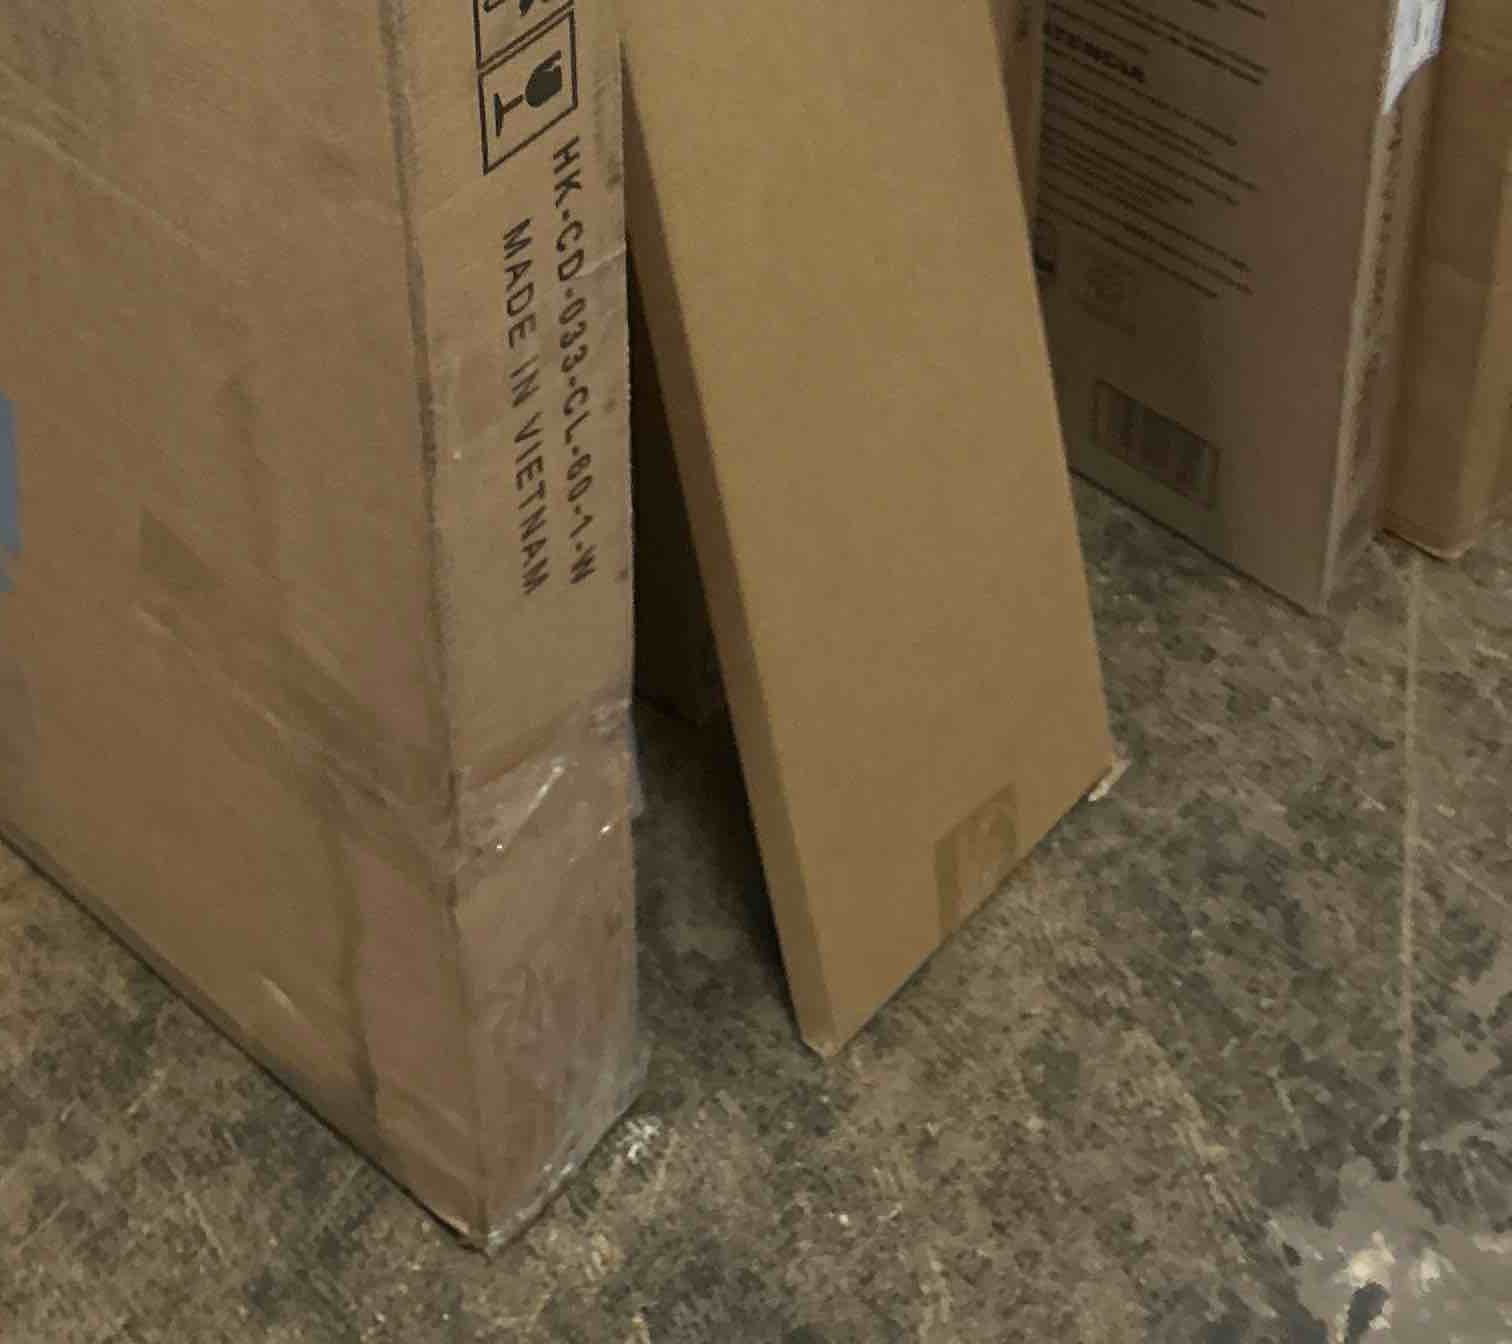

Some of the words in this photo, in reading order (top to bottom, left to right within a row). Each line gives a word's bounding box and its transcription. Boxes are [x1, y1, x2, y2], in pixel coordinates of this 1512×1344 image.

[502, 216, 536, 350] MADE
[508, 358, 542, 409] IN
[513, 410, 551, 596] VIETNAM
